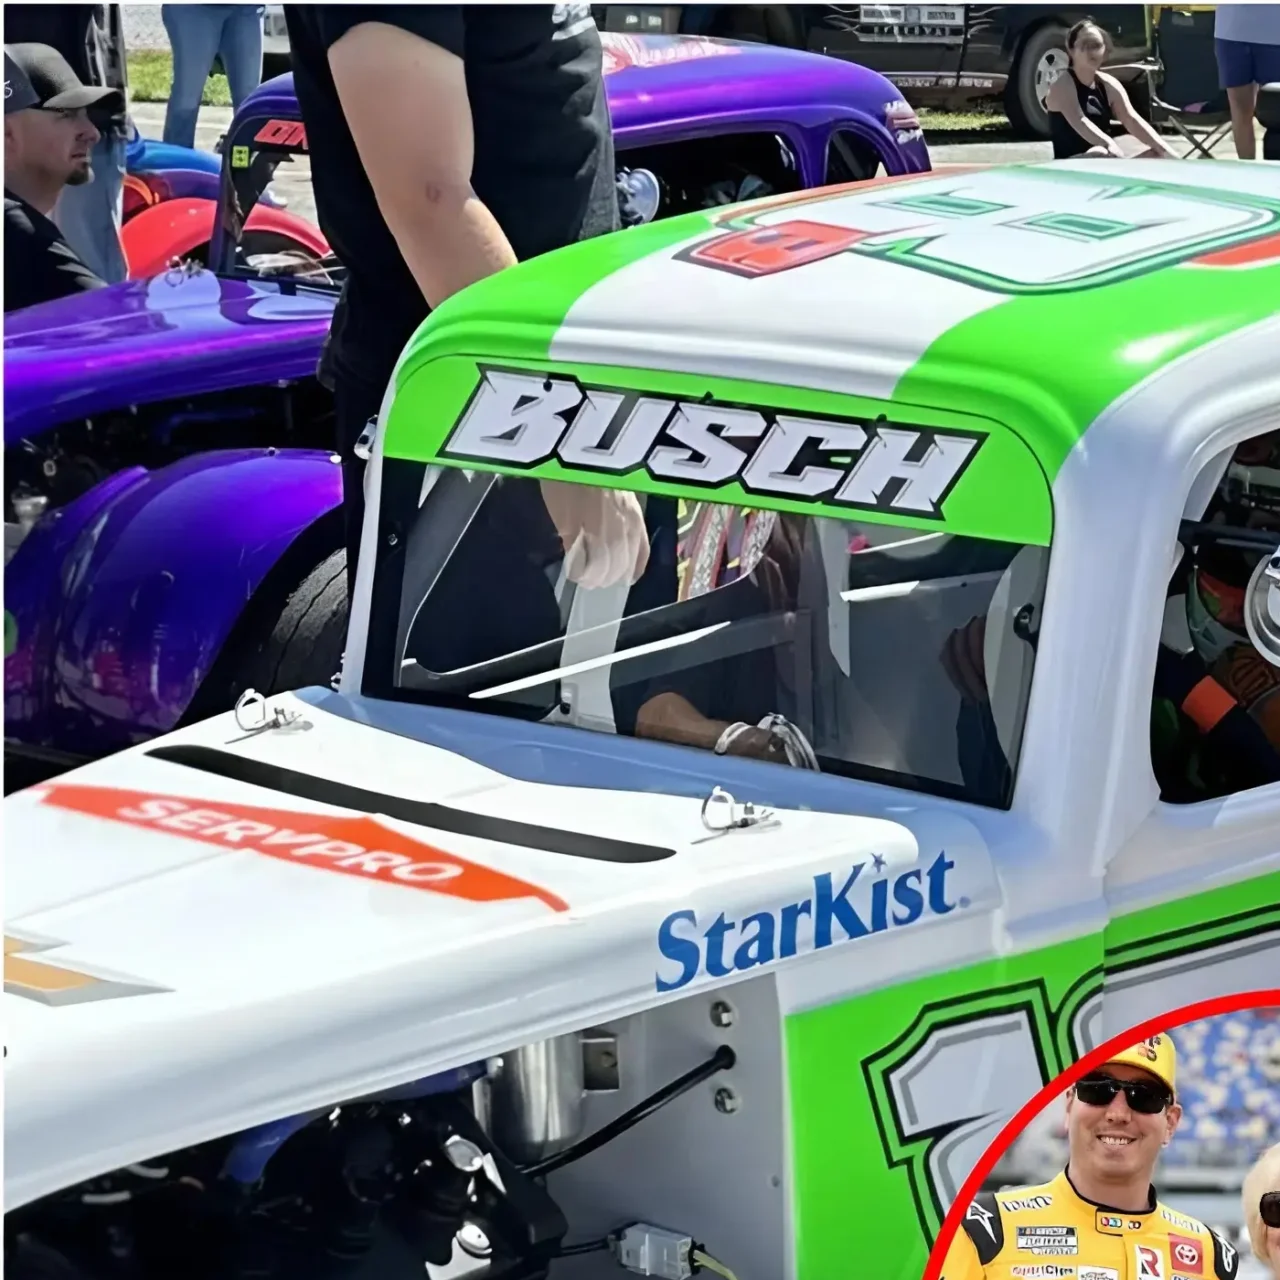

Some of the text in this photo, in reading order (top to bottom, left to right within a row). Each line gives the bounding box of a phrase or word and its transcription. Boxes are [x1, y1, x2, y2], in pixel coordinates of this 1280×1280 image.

[440, 364, 992, 521] BUSCH
[116, 797, 467, 885] SERVPRO
[655, 850, 956, 994] StarKist
